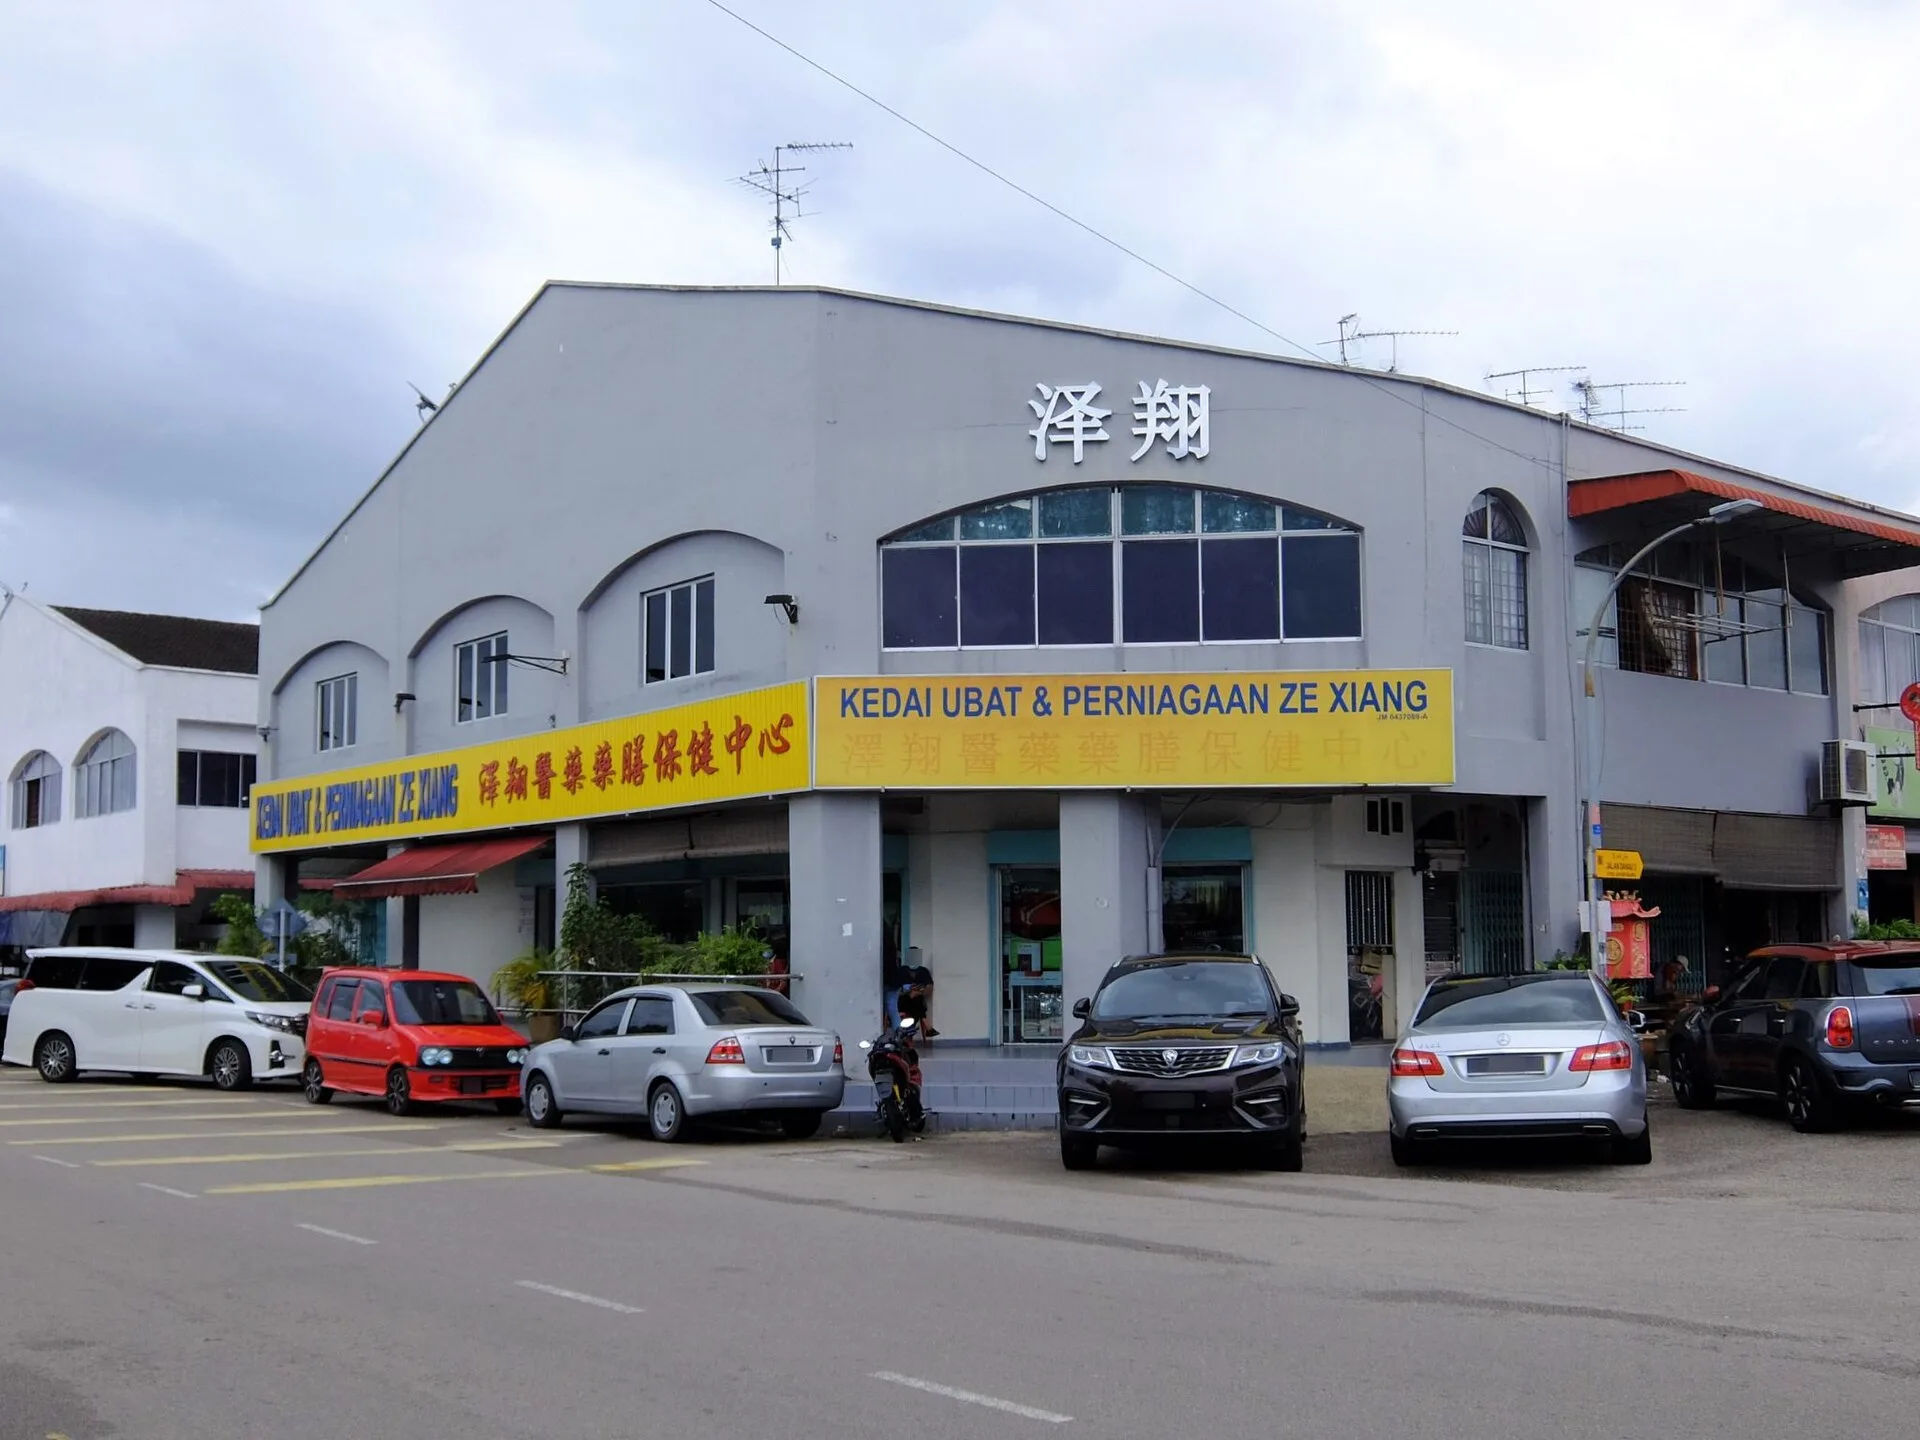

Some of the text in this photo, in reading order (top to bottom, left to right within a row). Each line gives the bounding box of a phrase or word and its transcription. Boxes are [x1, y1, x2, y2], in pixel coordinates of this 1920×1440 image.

[1028, 378, 1211, 464] 泽翔
[841, 680, 1428, 718] KEDAI UBAT & PERNIAGAAN ZE XIANG
[479, 713, 793, 807] 澤翔醫藥藥膳保健中心
[841, 728, 1427, 777] 澤翔醫藥藥膳保健中心
[324, 774, 397, 832] PERNIAGAAN
[398, 771, 415, 824] ZE
[417, 763, 458, 821] XIANG
